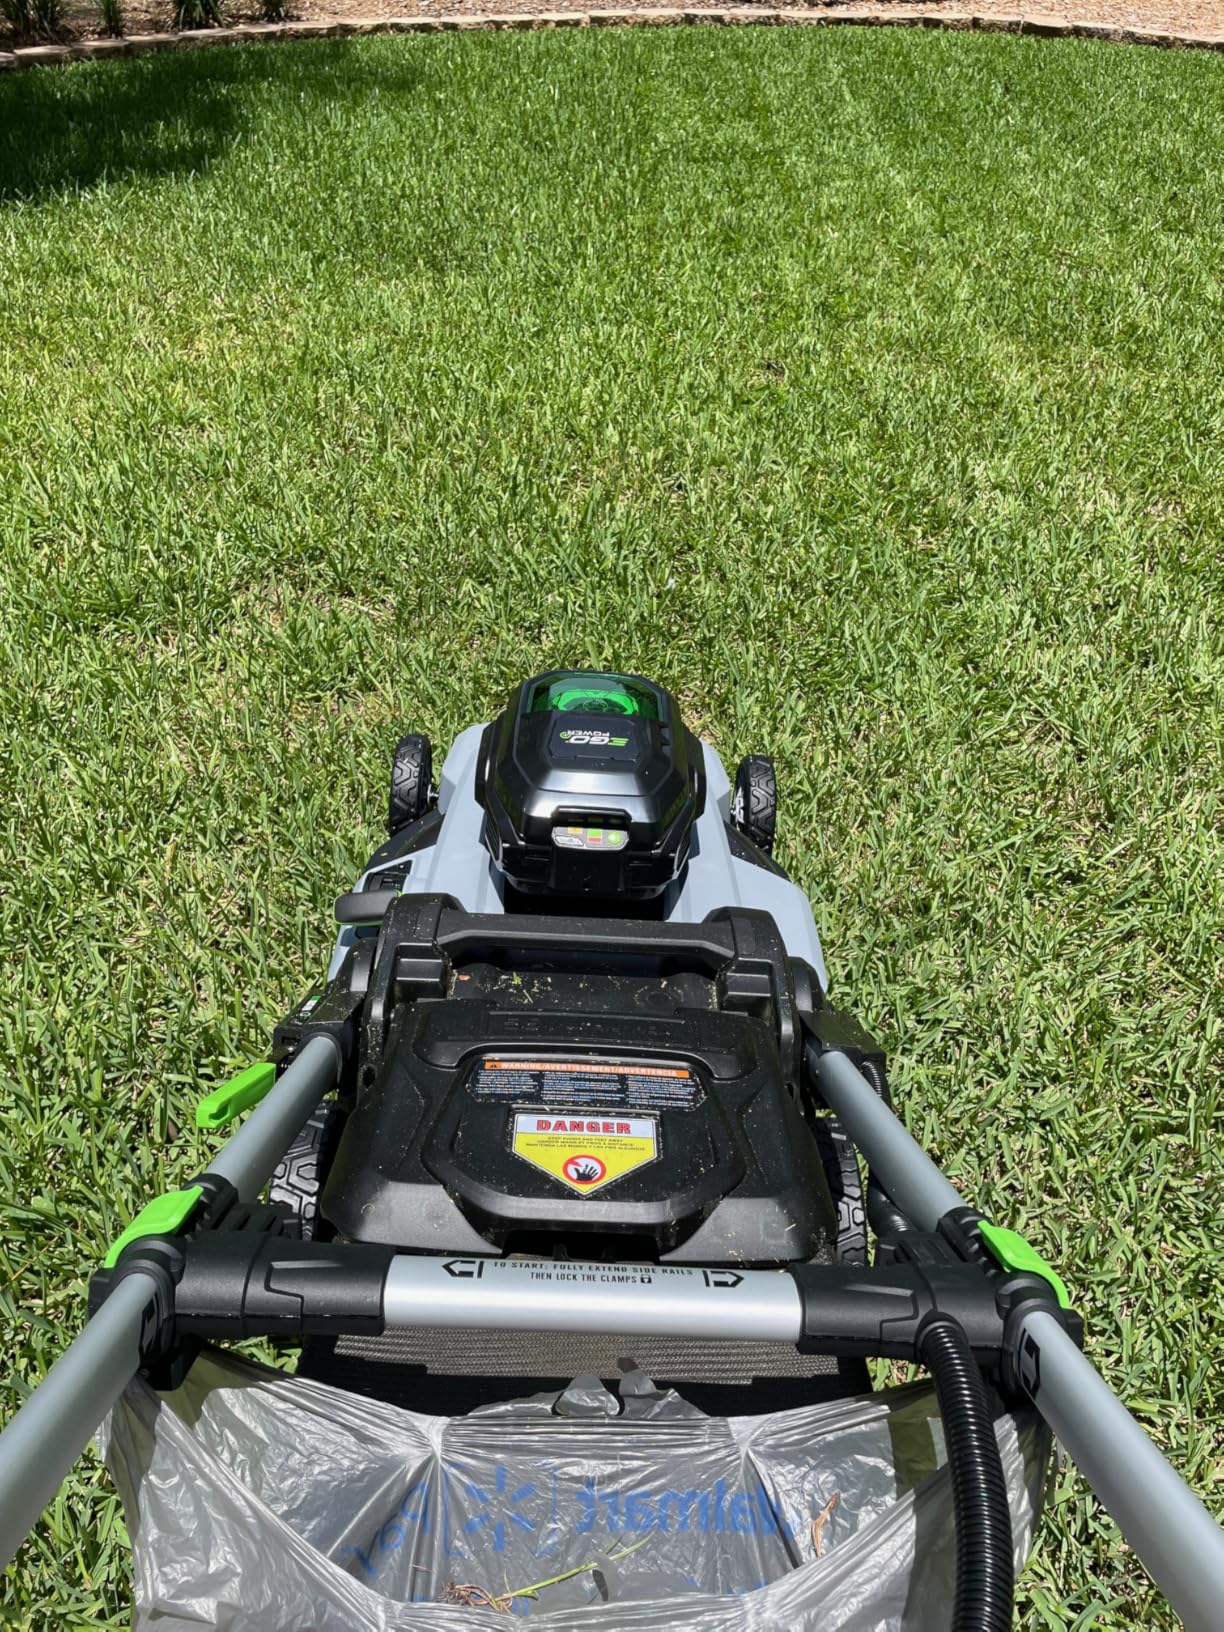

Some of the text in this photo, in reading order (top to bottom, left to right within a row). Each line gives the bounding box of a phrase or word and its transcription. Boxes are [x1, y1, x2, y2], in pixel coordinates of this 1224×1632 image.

[569, 735, 629, 747] EGO
[536, 1119, 631, 1134] DANGER
[553, 1263, 583, 1271] FULLY
[588, 1264, 627, 1272] EXTEND
[632, 1266, 657, 1274] SIDE
[661, 1267, 694, 1275] RAILS
[530, 1271, 637, 1284] THEN LOCK THE CLAMPS
